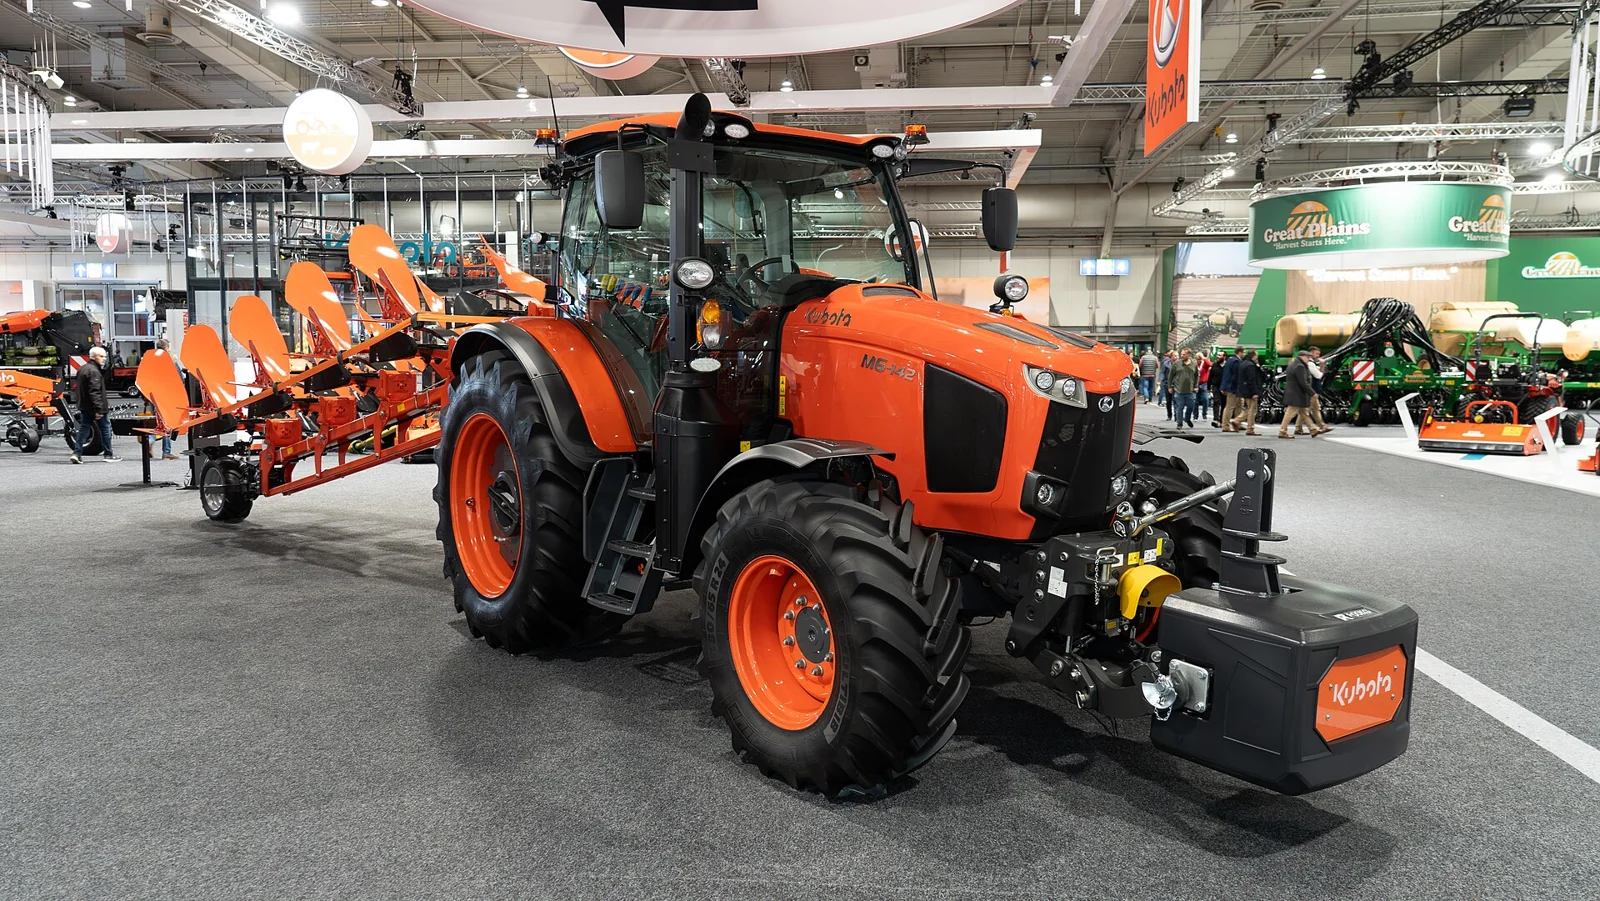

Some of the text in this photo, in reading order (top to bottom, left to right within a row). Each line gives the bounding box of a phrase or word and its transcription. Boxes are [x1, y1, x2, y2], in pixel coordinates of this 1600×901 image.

[1148, 69, 1185, 127] Kubota
[1263, 220, 1371, 243] Great Plains
[1448, 215, 1493, 232] Great
[1301, 239, 1323, 247] Starts
[803, 307, 852, 327] Kubota
[861, 353, 917, 382] M6-142
[1333, 671, 1392, 706] Kubota
